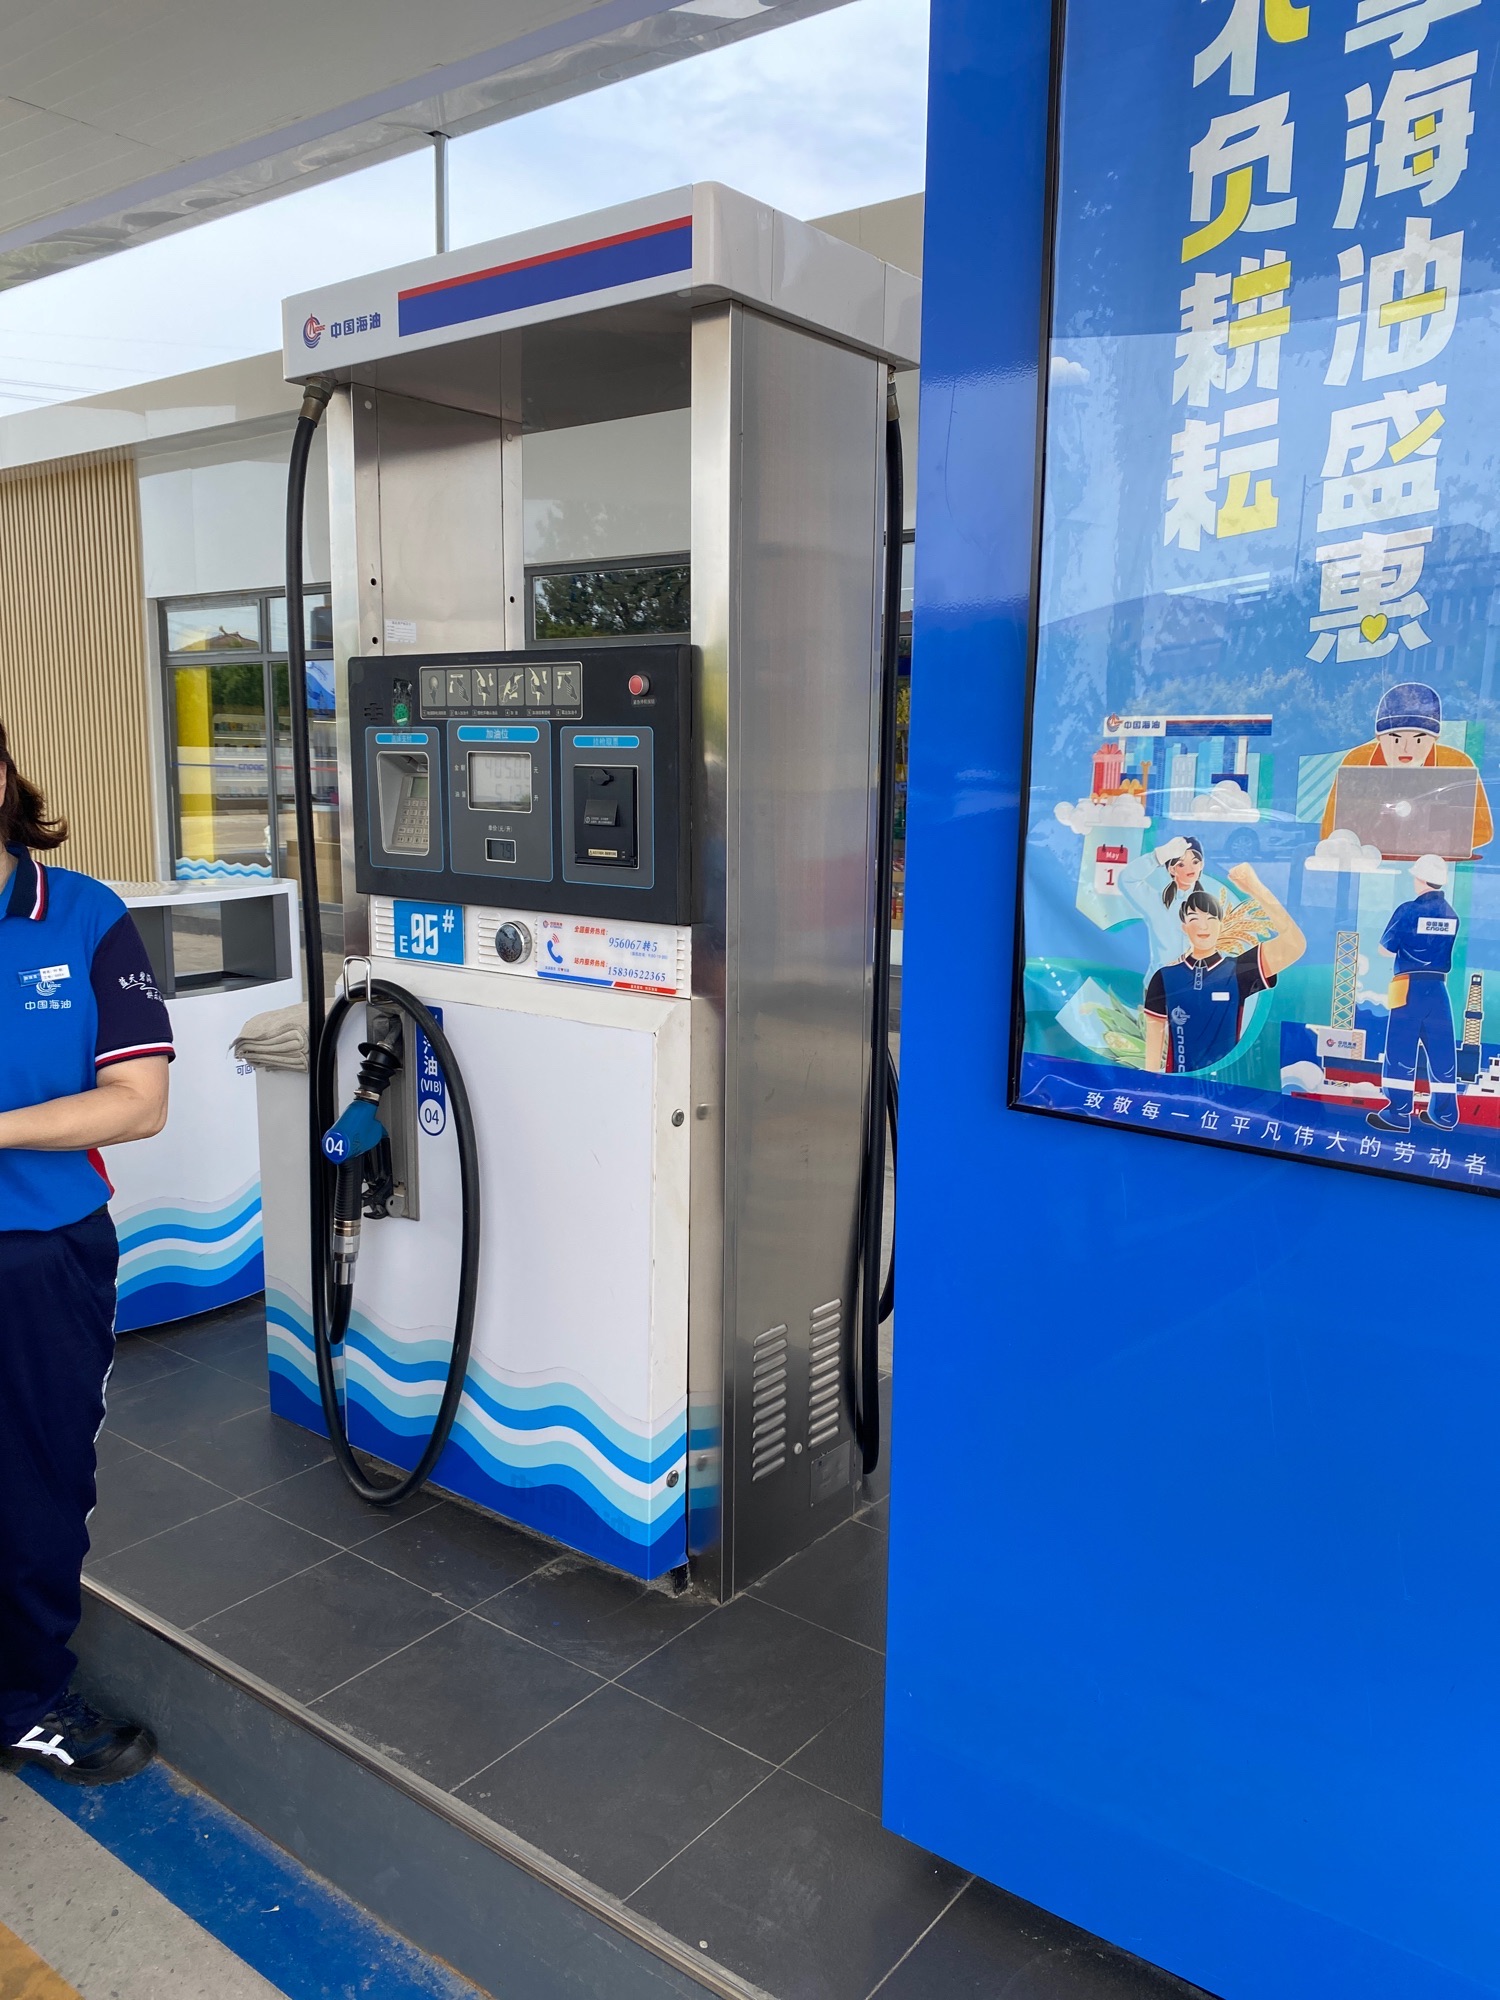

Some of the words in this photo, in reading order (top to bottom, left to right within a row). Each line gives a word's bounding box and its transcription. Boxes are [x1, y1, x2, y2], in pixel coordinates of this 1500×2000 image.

[1163, 0, 1310, 551] 不负耕耘
[330, 312, 381, 338] 中国海油
[1123, 720, 1161, 730] 中国海油
[485, 728, 509, 740] 加油位
[533, 766, 539, 774] 元
[533, 794, 539, 802] 升
[1105, 851, 1120, 860] May
[1105, 868, 1115, 886] 1
[608, 936, 658, 953] 956067转5
[607, 966, 666, 982] 15830522365
[24, 999, 72, 1011] 中国海油
[235, 1063, 257, 1076] 可回
[424, 1107, 439, 1125] 04
[1083, 1090, 1488, 1176] 致敬每一位平凡伟大的劳动者
[325, 1137, 344, 1156] 04
